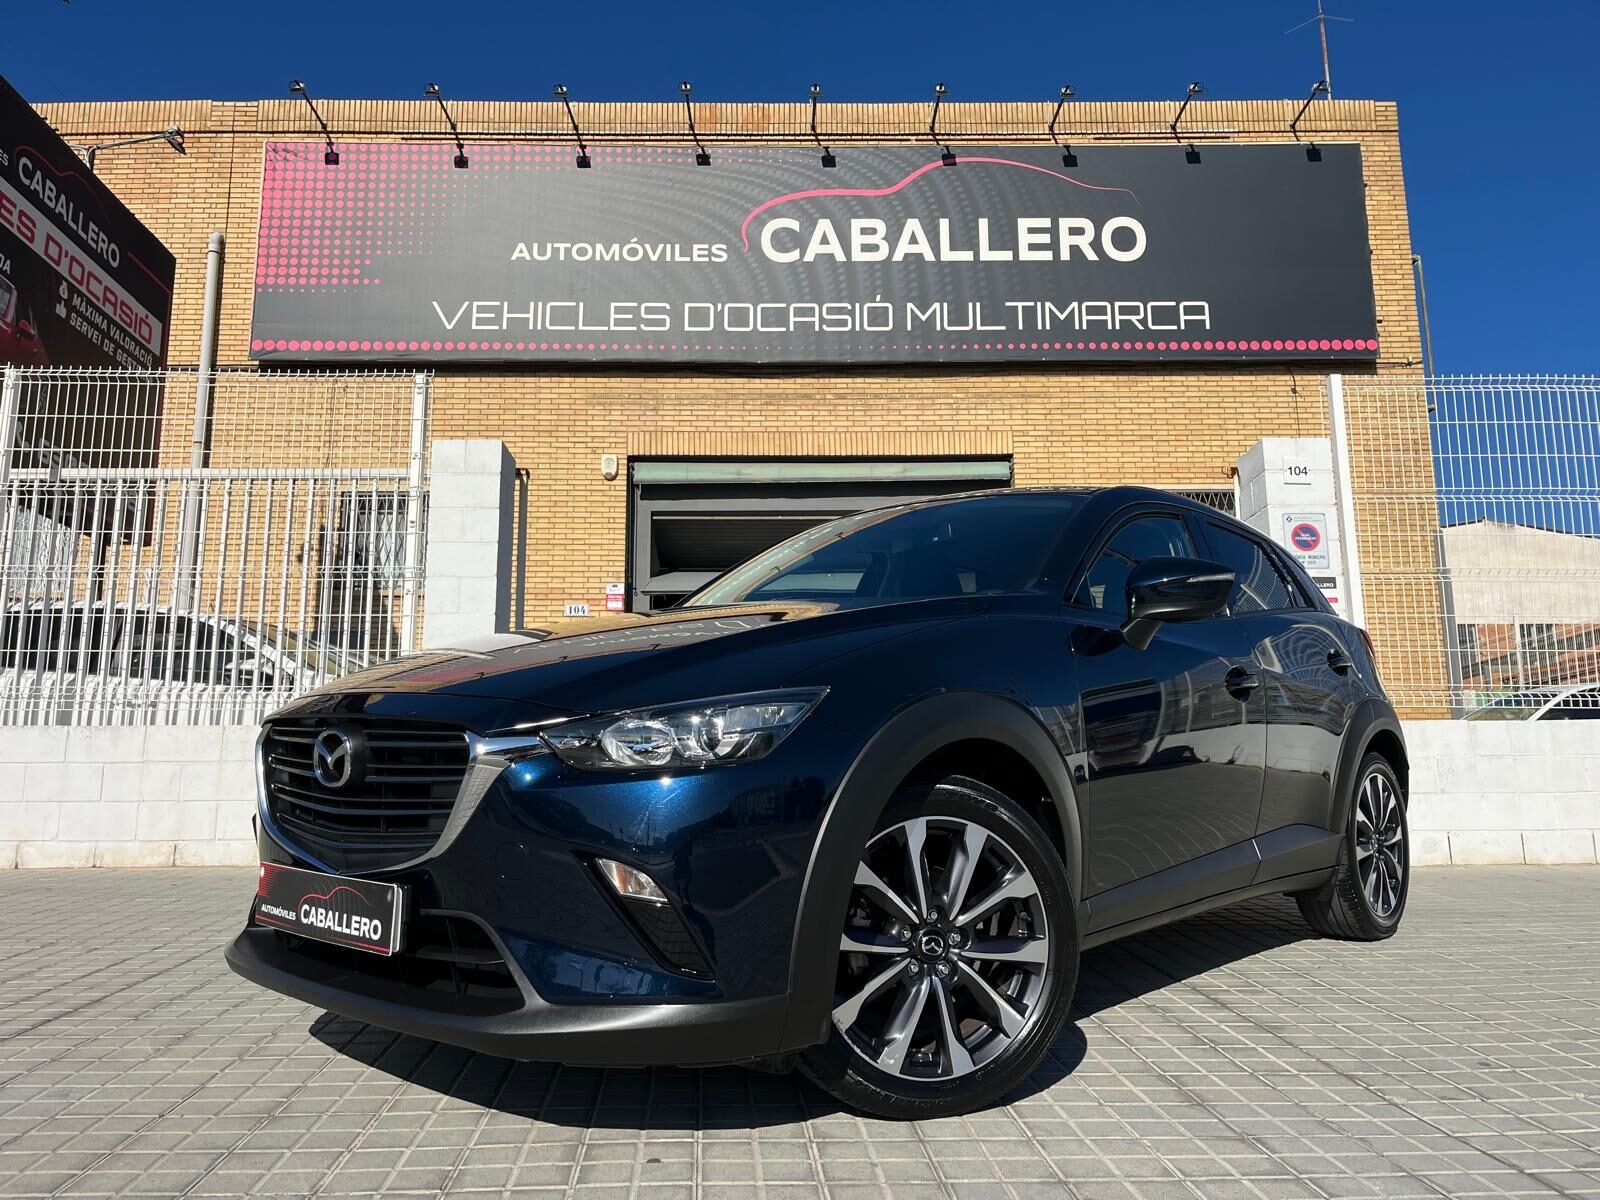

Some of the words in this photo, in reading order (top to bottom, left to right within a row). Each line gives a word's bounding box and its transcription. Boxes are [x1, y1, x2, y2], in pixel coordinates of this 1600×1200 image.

[18, 157, 120, 268] CABALLERO
[511, 238, 728, 262] AUTOMÓVILES
[760, 216, 1147, 263] CABALLERO
[44, 231, 153, 345] D'OCASIÓ
[70, 312, 102, 346] SERVEI
[103, 338, 115, 356] DE
[432, 301, 670, 331] VEHICLES
[684, 295, 893, 332] D'OCASIÓ
[907, 301, 1211, 331] MULTIMARCA
[110, 324, 153, 367] VALORACIÓ
[1287, 466, 1308, 476] 104
[568, 606, 586, 615] 104
[261, 903, 296, 920] AUTOMÓVILES
[301, 904, 382, 940] CABALLERO
